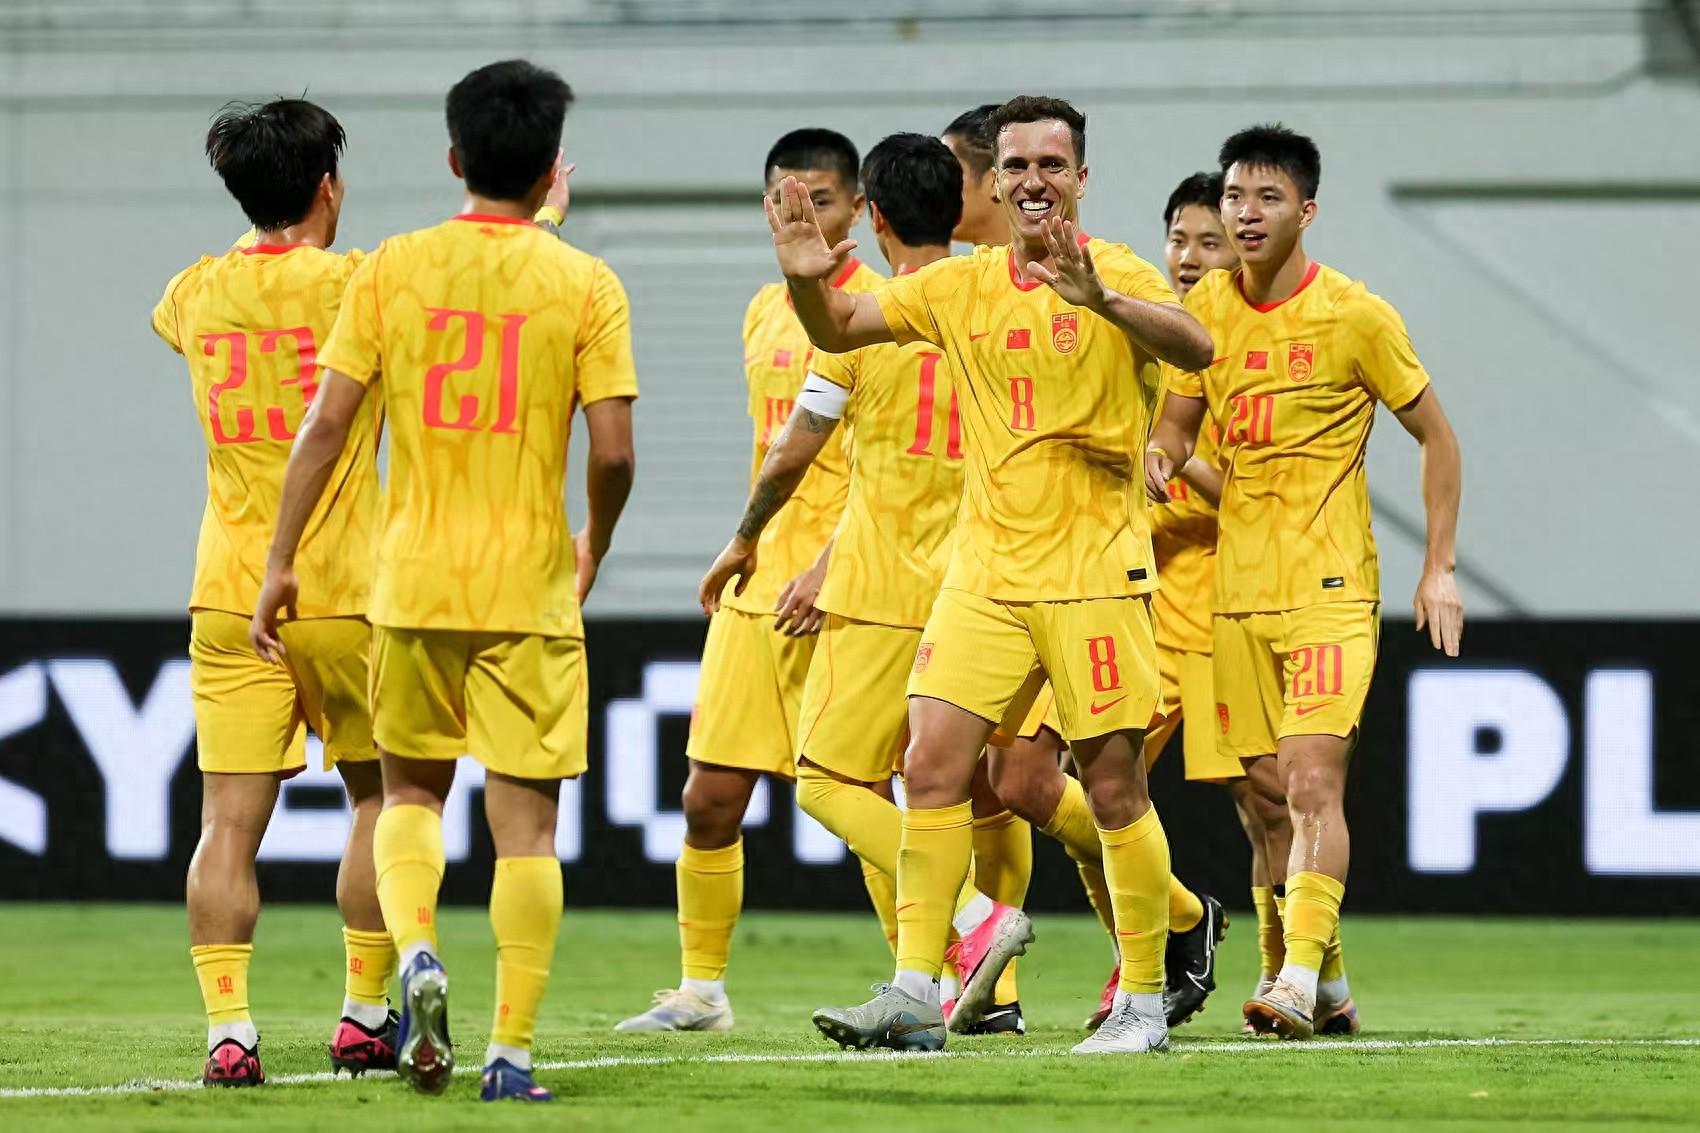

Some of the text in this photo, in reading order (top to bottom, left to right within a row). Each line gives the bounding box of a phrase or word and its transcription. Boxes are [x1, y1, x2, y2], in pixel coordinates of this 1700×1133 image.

[196, 326, 319, 445] 23
[422, 306, 528, 435] 21
[1007, 377, 1037, 432] 8
[1228, 394, 1274, 447] 20
[1084, 635, 1125, 692] 8
[1288, 644, 1344, 698] 20
